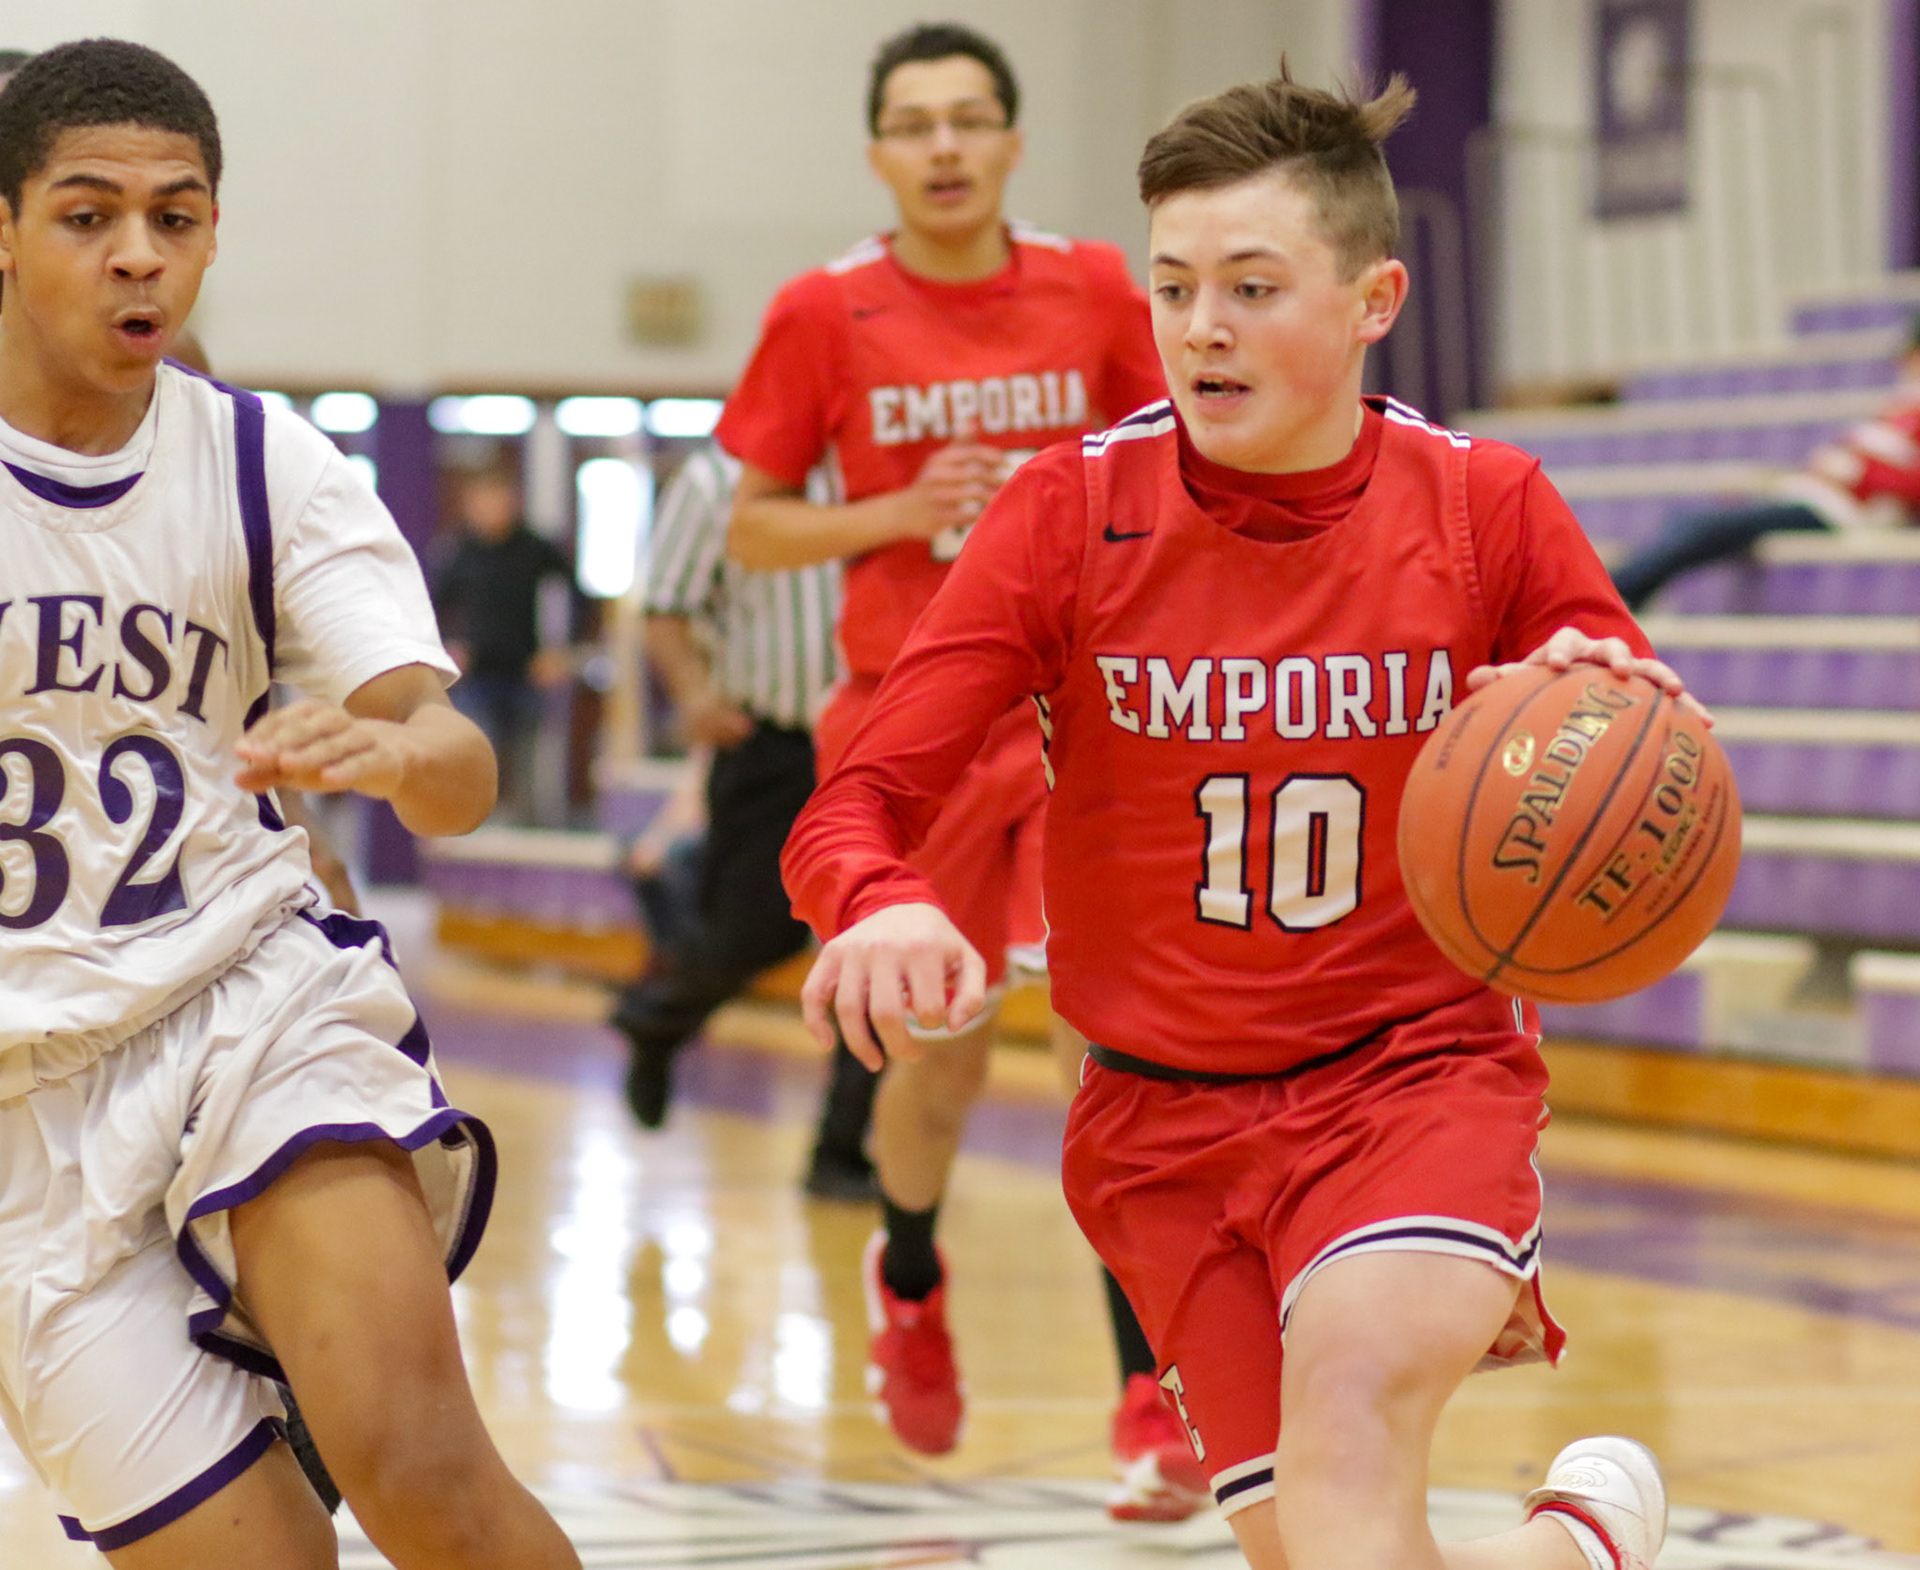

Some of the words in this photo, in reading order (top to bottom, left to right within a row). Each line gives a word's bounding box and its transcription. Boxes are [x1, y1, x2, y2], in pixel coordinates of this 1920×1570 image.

[868, 369, 1087, 446] EMPORIA
[0, 593, 228, 724] EST
[1095, 648, 1454, 741] EMPORIA
[0, 736, 189, 930] 32
[1193, 772, 1366, 933] 10
[1491, 682, 1637, 886] SPALDING
